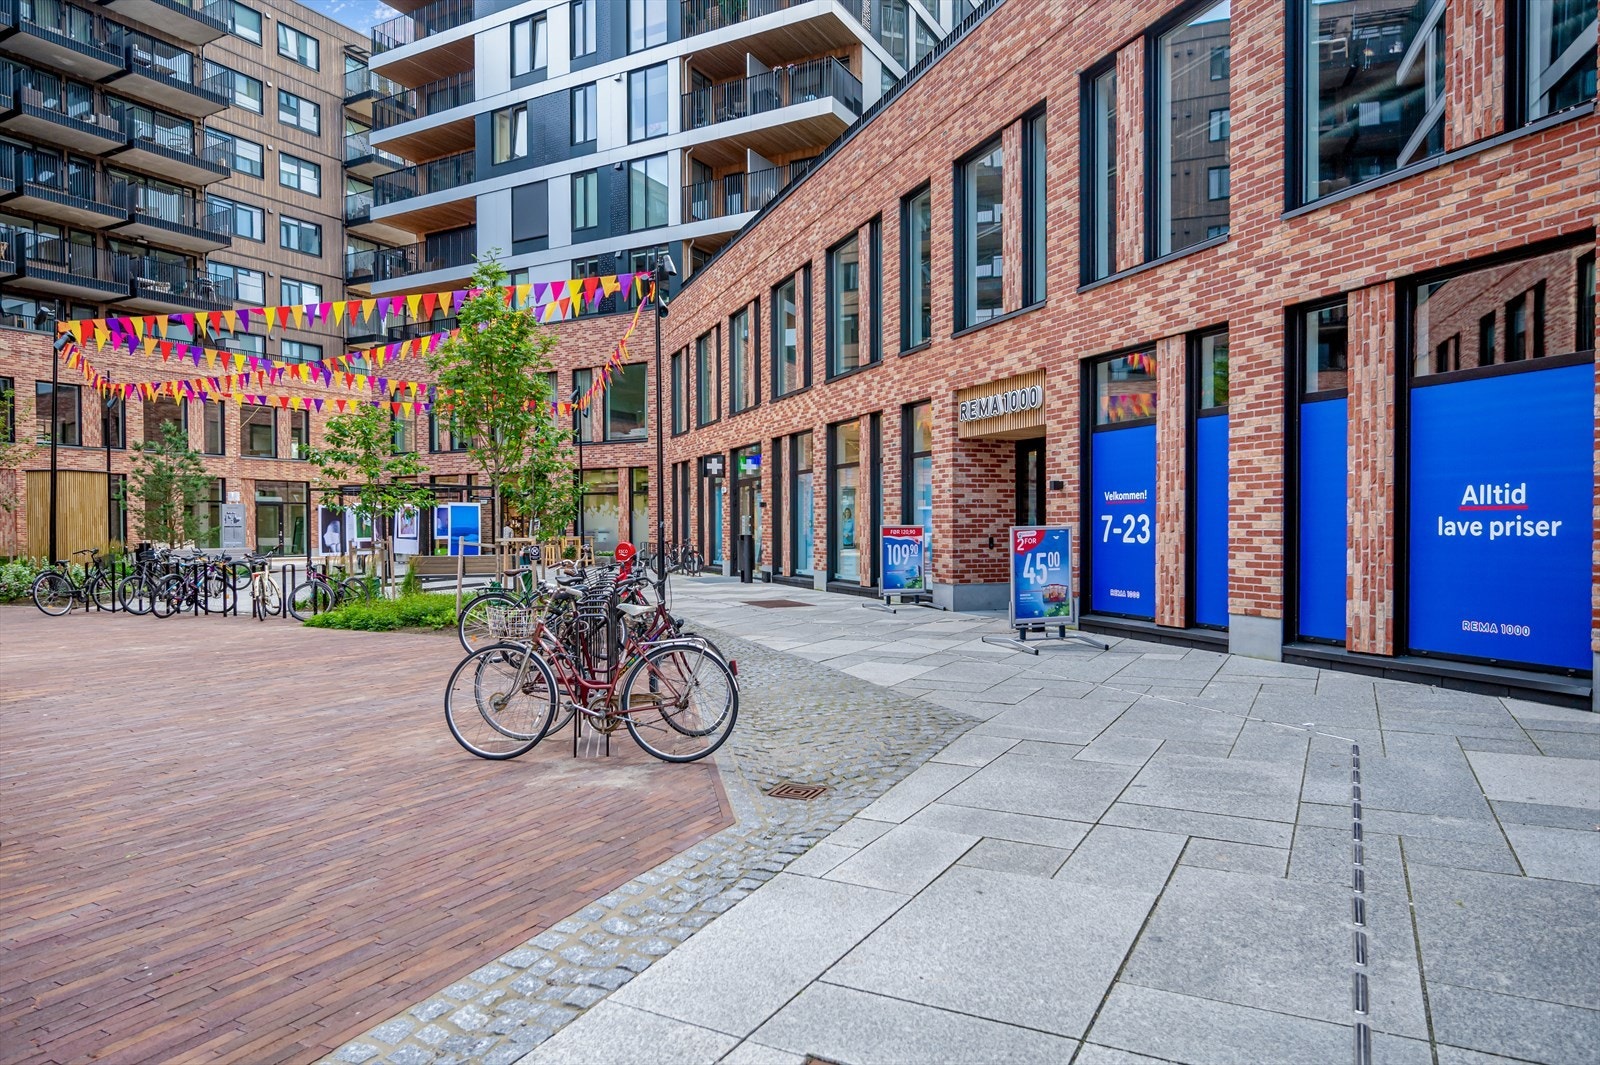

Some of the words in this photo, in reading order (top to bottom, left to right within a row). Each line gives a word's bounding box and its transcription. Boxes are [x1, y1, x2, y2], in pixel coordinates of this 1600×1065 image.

[960, 394, 1002, 422] REMA
[1003, 385, 1041, 414] 1000
[1104, 490, 1148, 501] Velkommen!
[1461, 482, 1527, 505] Alltid
[1101, 514, 1150, 544] 7-23
[1438, 516, 1483, 536] lave
[1489, 515, 1562, 540] priser
[1016, 538, 1025, 551] 2
[1023, 552, 1048, 585] 45
[1462, 620, 1498, 634] REMA
[1500, 623, 1531, 637] 1000
